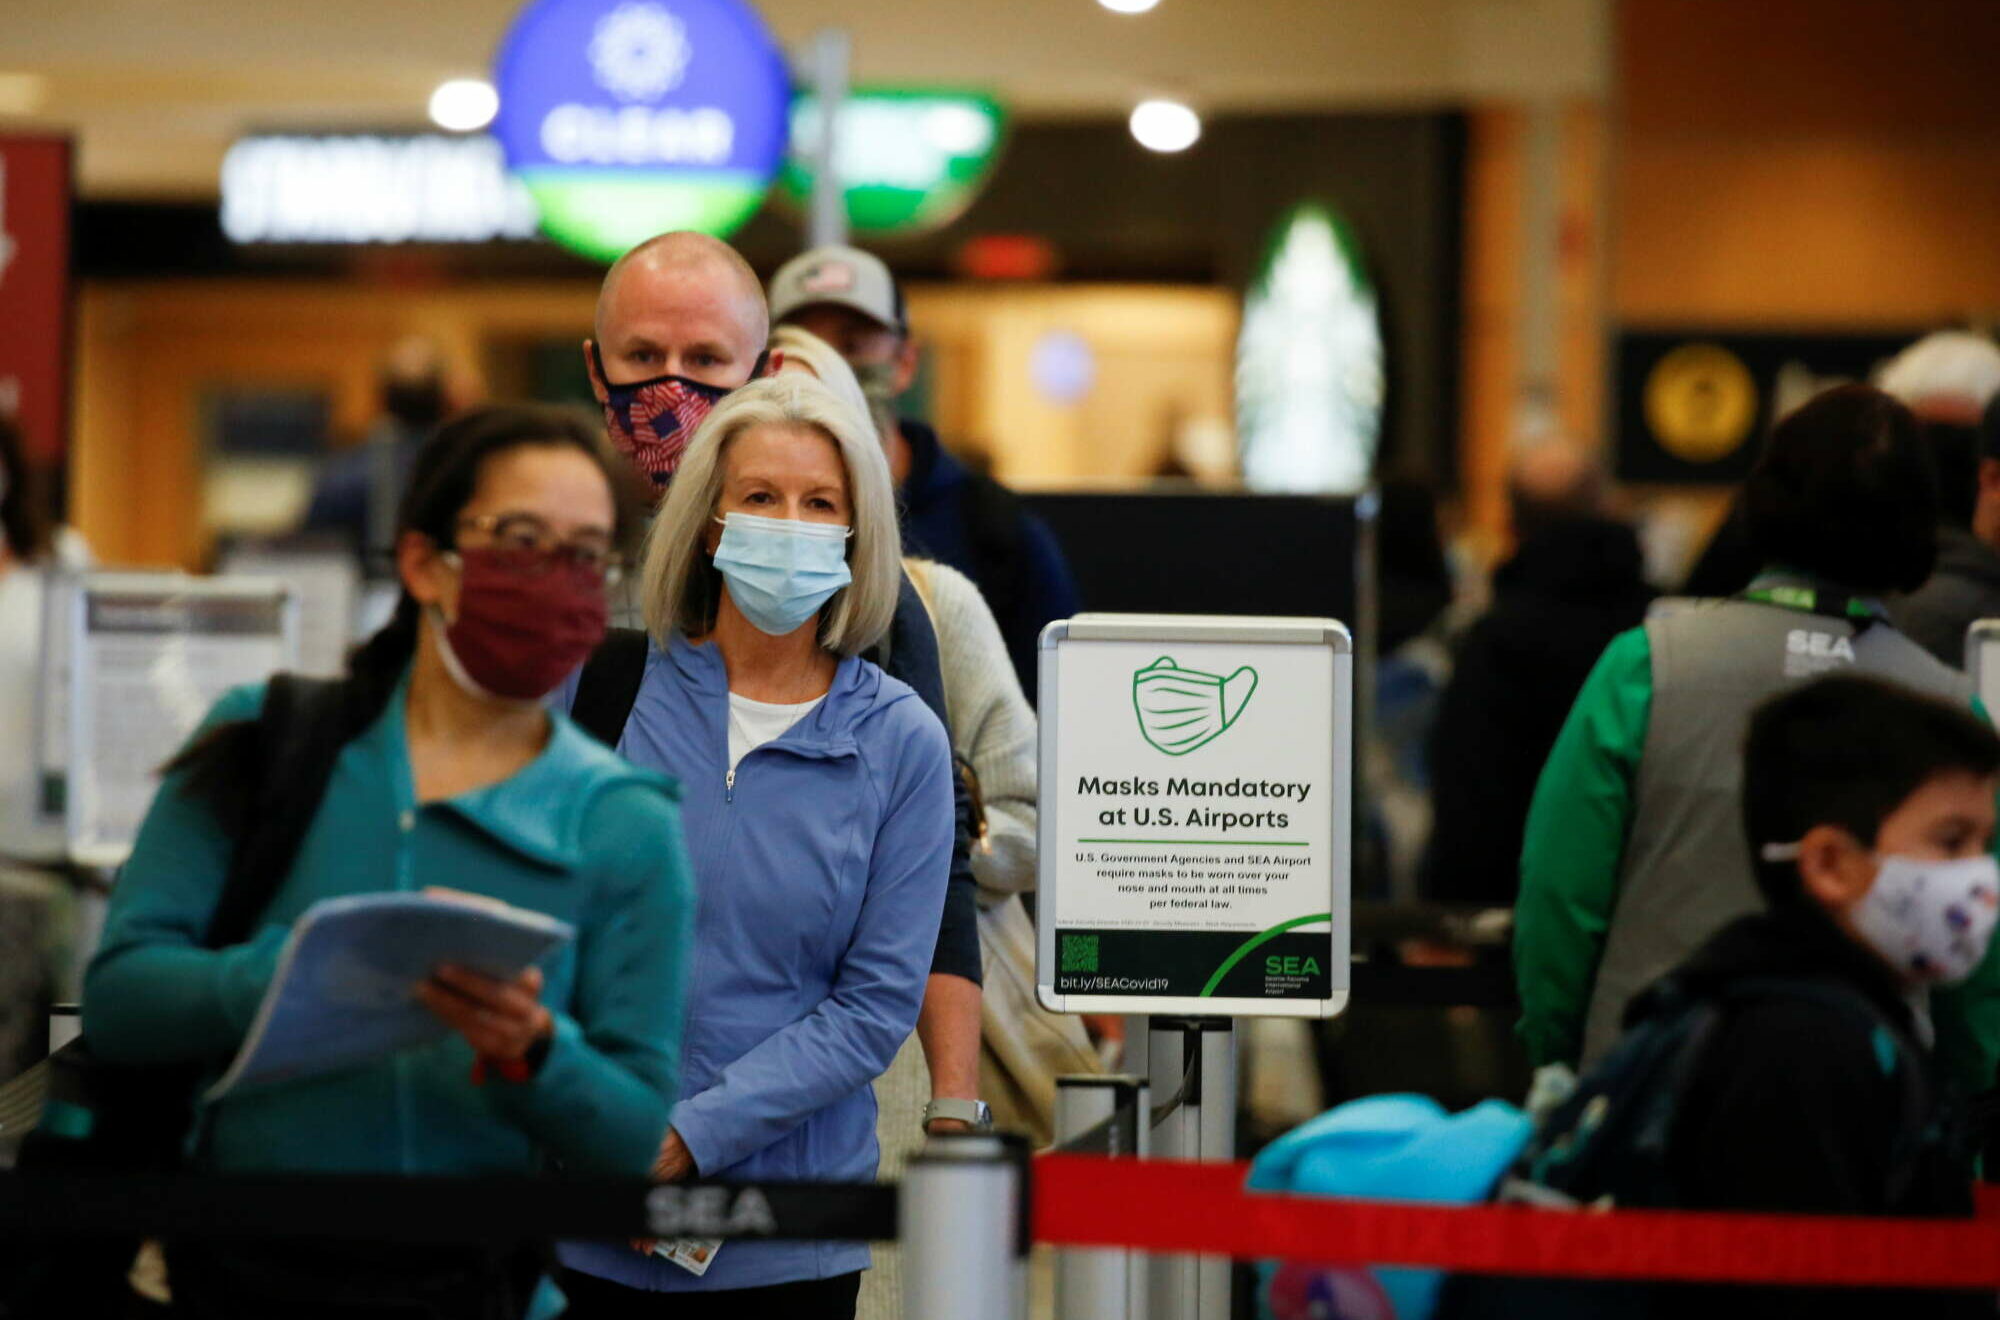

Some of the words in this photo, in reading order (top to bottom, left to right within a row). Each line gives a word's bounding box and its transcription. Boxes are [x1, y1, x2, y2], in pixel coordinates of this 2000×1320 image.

[1787, 629, 1855, 663] SEA
[1078, 776, 1159, 796] Masks
[1166, 778, 1311, 803] Mandatory
[1099, 808, 1126, 826] at
[1134, 807, 1179, 827] U.S.
[1186, 807, 1289, 831] Airports
[1075, 853, 1098, 863] U.S.
[1101, 853, 1167, 864] Government
[1171, 855, 1221, 867] Agencies
[1224, 855, 1244, 865] and
[1247, 855, 1270, 865] SEA
[1273, 856, 1311, 867] Airport
[1097, 869, 1135, 880] require
[1138, 868, 1174, 878] masks
[1177, 869, 1188, 879] to
[1191, 869, 1204, 879] be
[1207, 871, 1234, 879] worn
[1237, 871, 1261, 880] over
[1265, 872, 1289, 882] your
[1118, 884, 1145, 893] nose
[1147, 884, 1168, 893] and
[1171, 884, 1206, 894] mouth
[1209, 885, 1219, 894] at
[1222, 884, 1235, 894] all
[1238, 885, 1268, 895] times
[1150, 900, 1167, 910] per
[1171, 899, 1208, 909] federal
[1211, 899, 1232, 909] law.
[1265, 955, 1321, 976] SEA
[1060, 976, 1169, 991] bit.ly/SEACovid19
[646, 1186, 776, 1234] SEA
